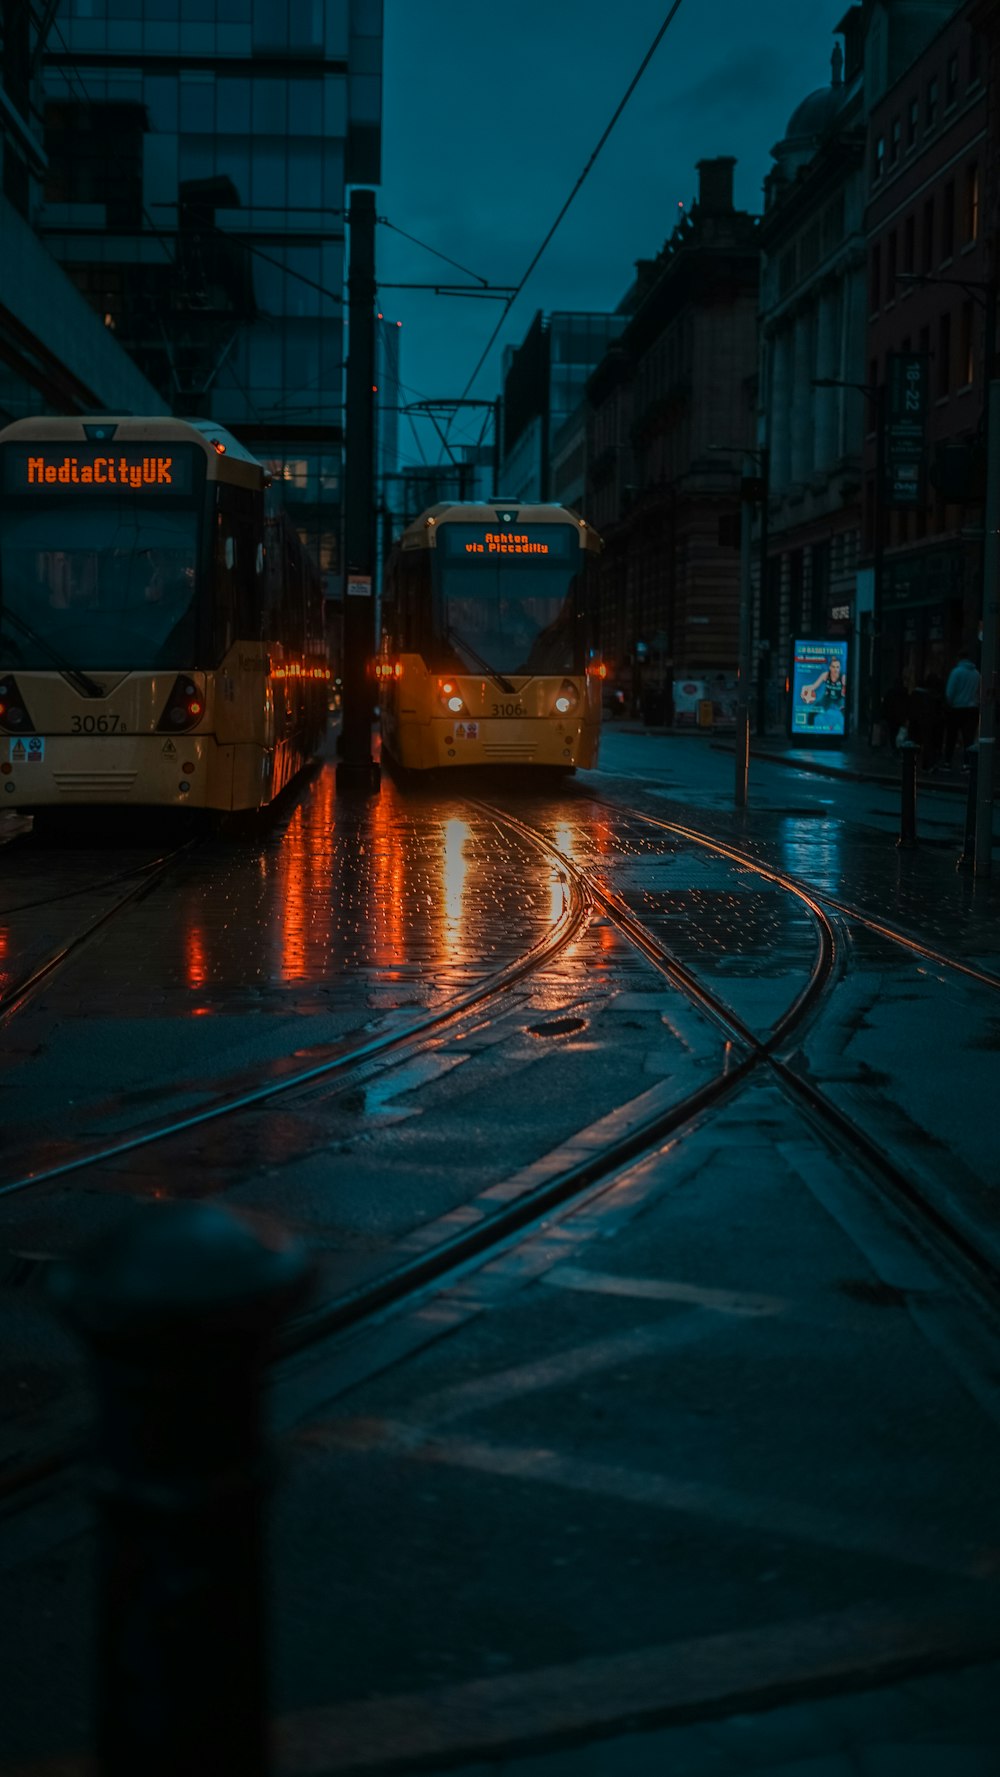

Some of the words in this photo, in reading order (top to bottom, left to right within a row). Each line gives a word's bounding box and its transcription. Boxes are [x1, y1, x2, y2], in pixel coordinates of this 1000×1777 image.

[27, 457, 173, 488] MediaCityUK
[485, 533, 529, 544] Ashton
[465, 543, 485, 553] via
[488, 543, 549, 554] Piccadilly
